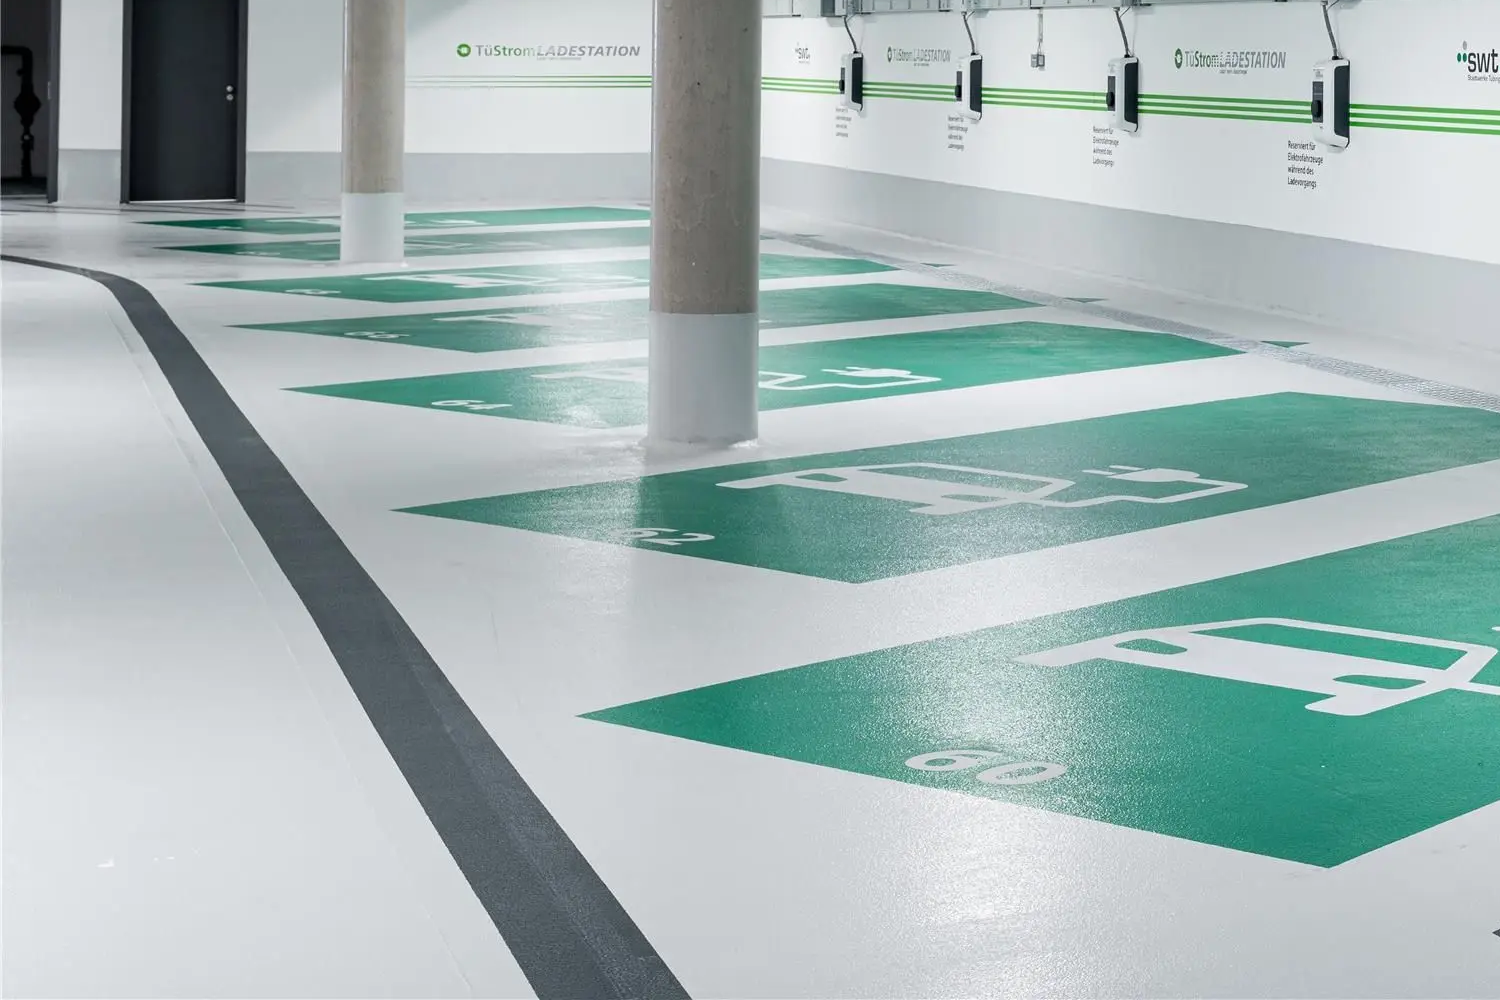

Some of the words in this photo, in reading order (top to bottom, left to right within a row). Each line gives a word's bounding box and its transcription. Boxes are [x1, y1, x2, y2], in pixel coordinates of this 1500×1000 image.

[431, 399, 512, 411] 64
[608, 527, 716, 546] 62
[904, 748, 1068, 785] 60
